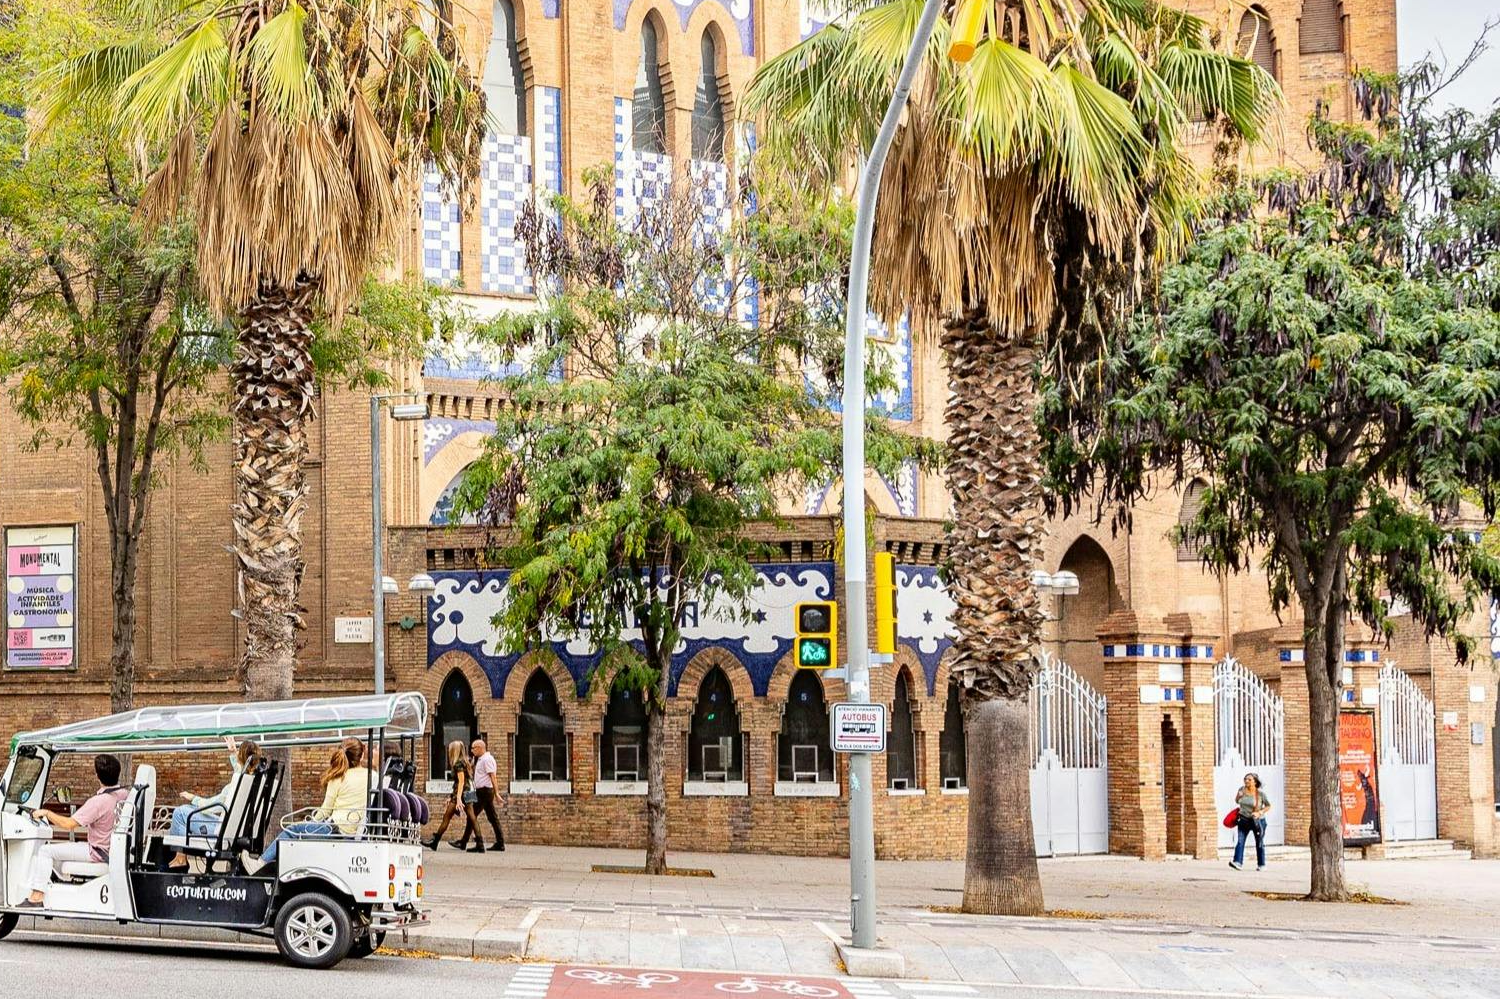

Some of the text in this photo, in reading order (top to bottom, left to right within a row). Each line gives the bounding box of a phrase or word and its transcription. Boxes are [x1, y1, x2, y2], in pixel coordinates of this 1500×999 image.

[20, 552, 60, 568] MONUMENTAL
[27, 586, 54, 594] MÚSICA
[14, 608, 68, 616] GASTRONOMÍA
[842, 713, 877, 721] AUTOBUS
[100, 884, 109, 904] 6
[166, 885, 246, 901] ECOTUKTUK.COM
